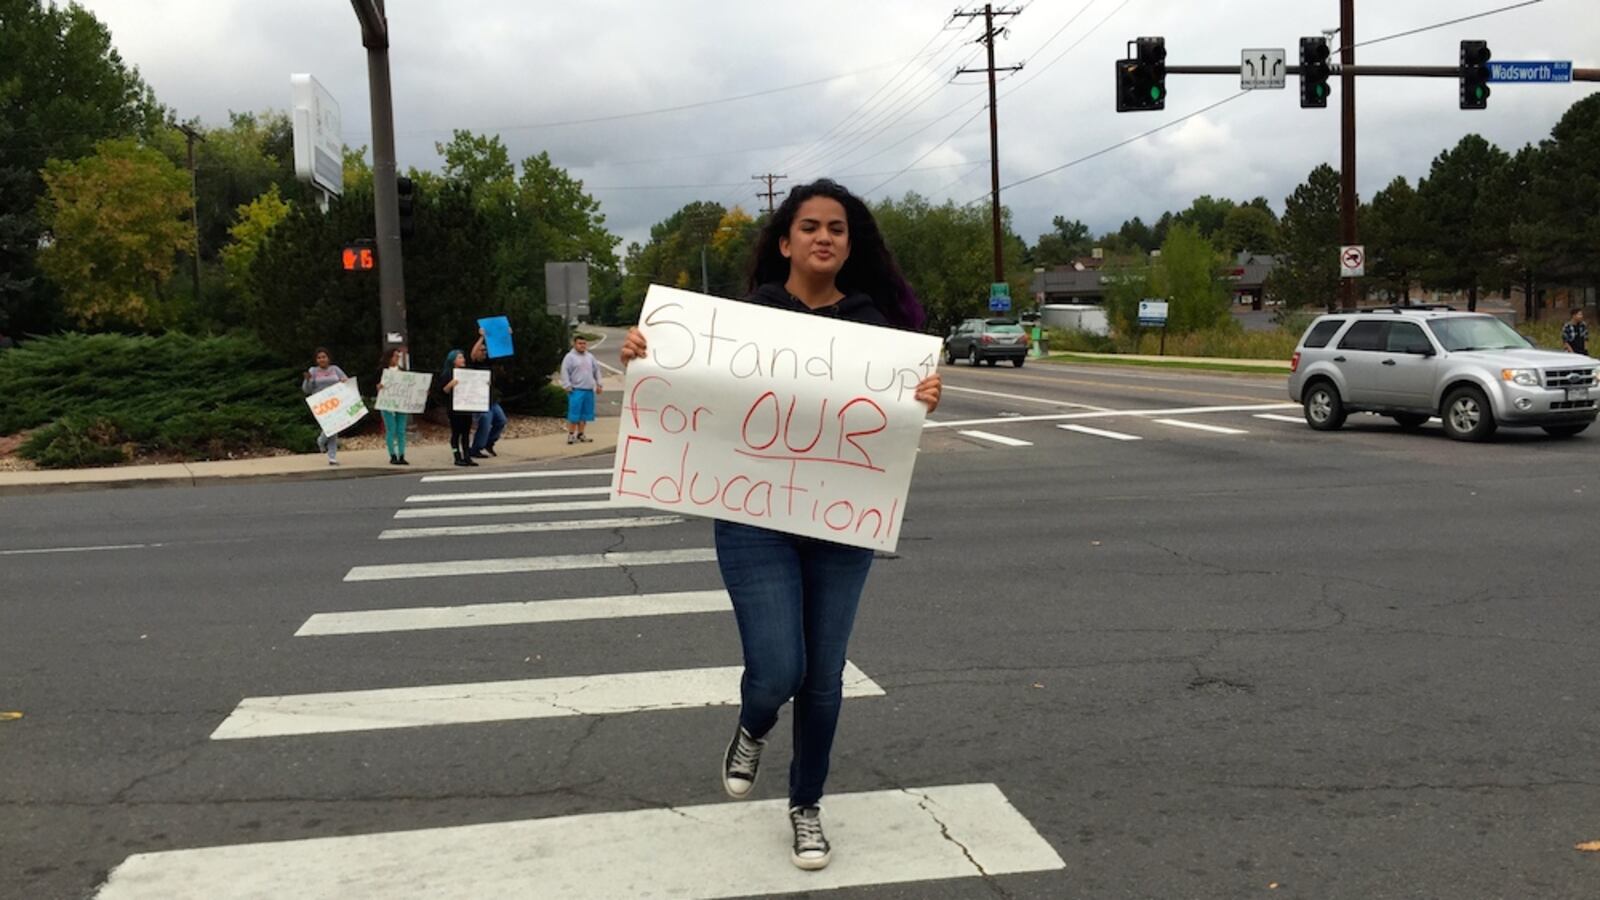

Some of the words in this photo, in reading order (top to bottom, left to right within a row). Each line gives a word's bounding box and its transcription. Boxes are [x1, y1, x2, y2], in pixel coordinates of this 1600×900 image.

[1491, 64, 1551, 80] Wadsworth
[645, 303, 834, 381] Stand
[865, 361, 922, 402] up
[624, 376, 713, 433] for
[742, 391, 888, 468] OUR
[617, 435, 898, 545] Education!
